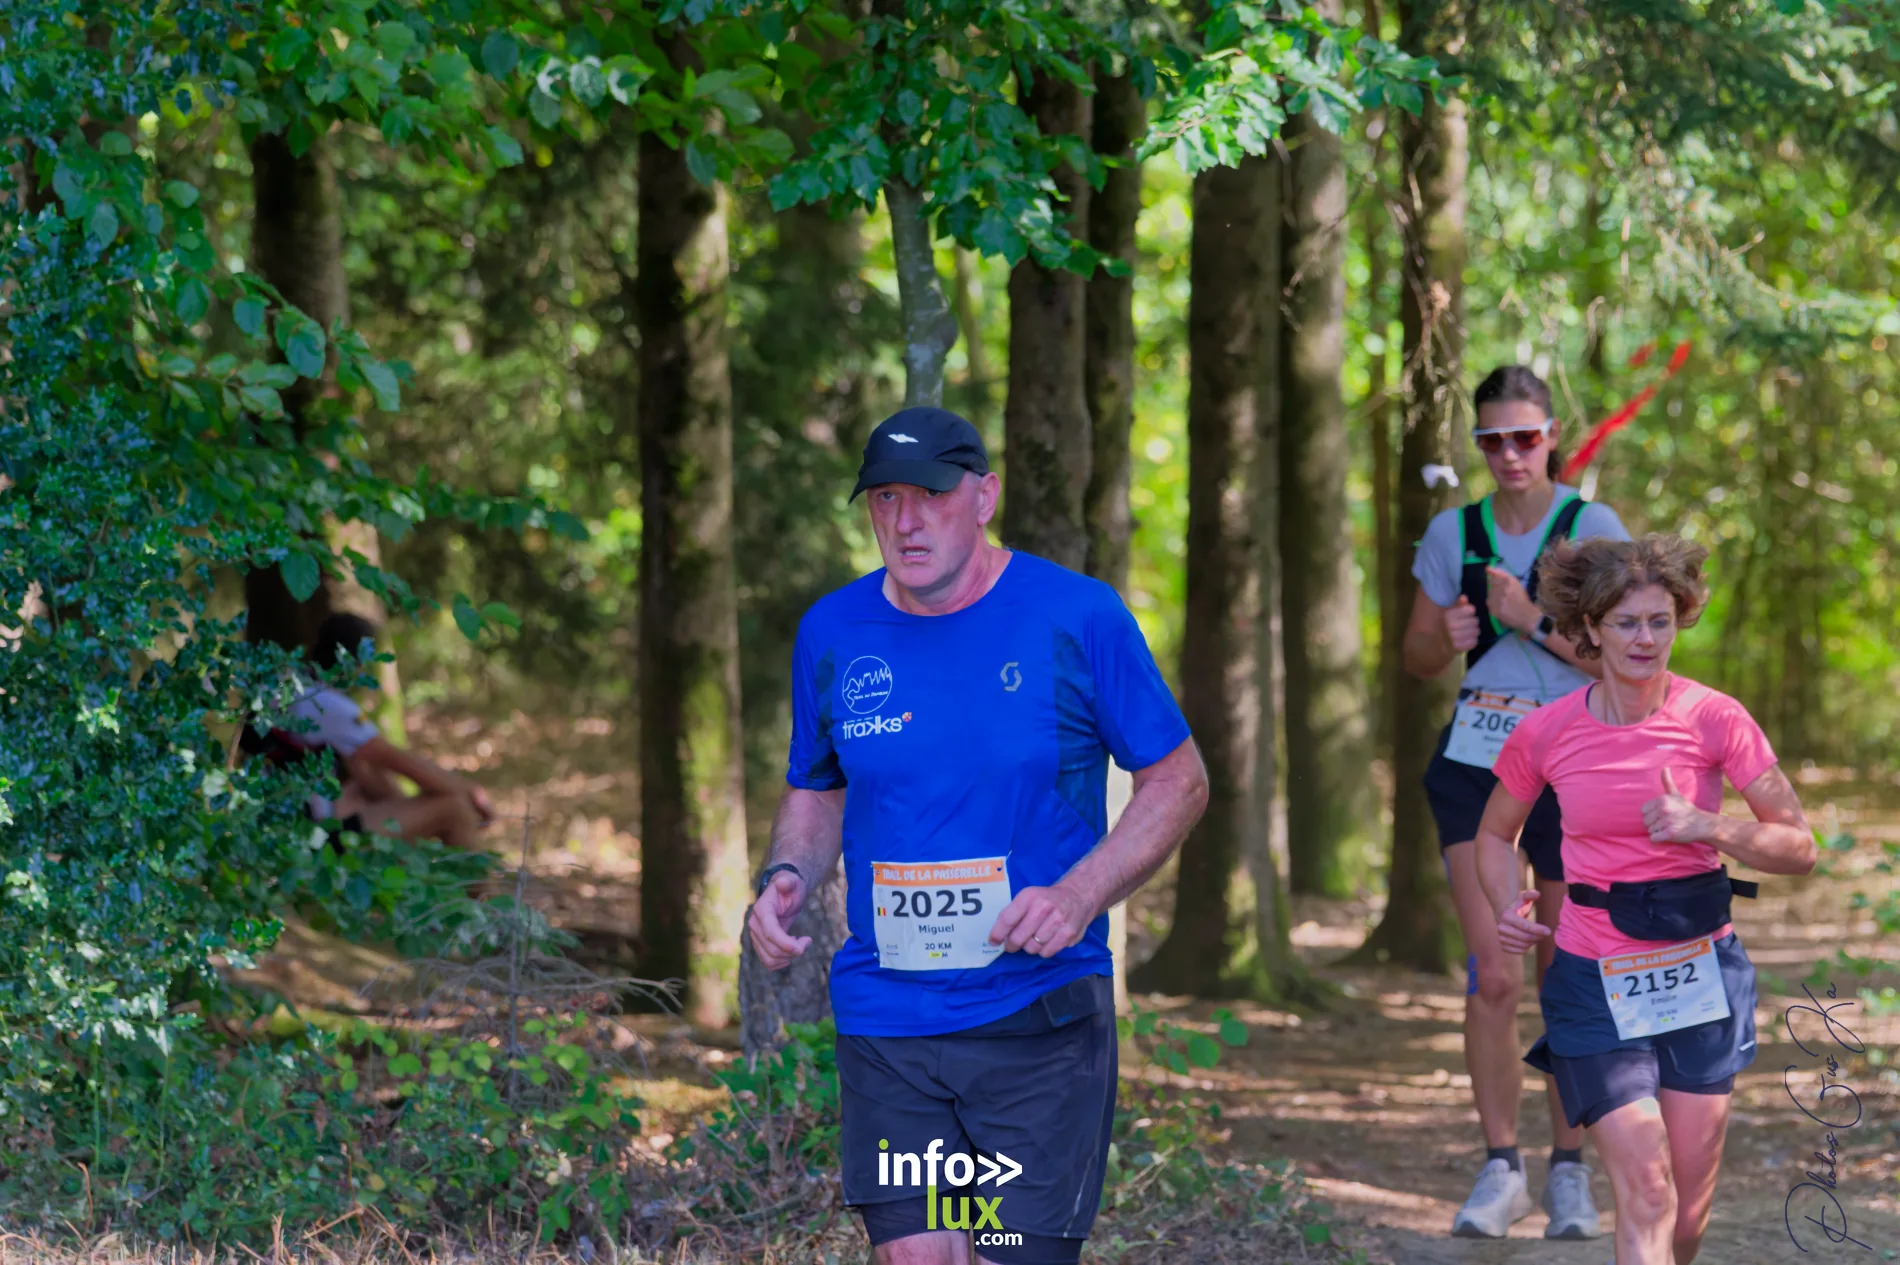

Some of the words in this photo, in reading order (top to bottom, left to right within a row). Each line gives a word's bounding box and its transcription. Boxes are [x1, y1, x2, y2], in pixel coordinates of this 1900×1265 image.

[917, 870, 931, 881] LA
[933, 866, 991, 880] PASSERELLE
[891, 888, 983, 918] 2025
[918, 924, 955, 935] Miguel
[938, 942, 952, 950] KM
[1624, 962, 1698, 997] 2152
